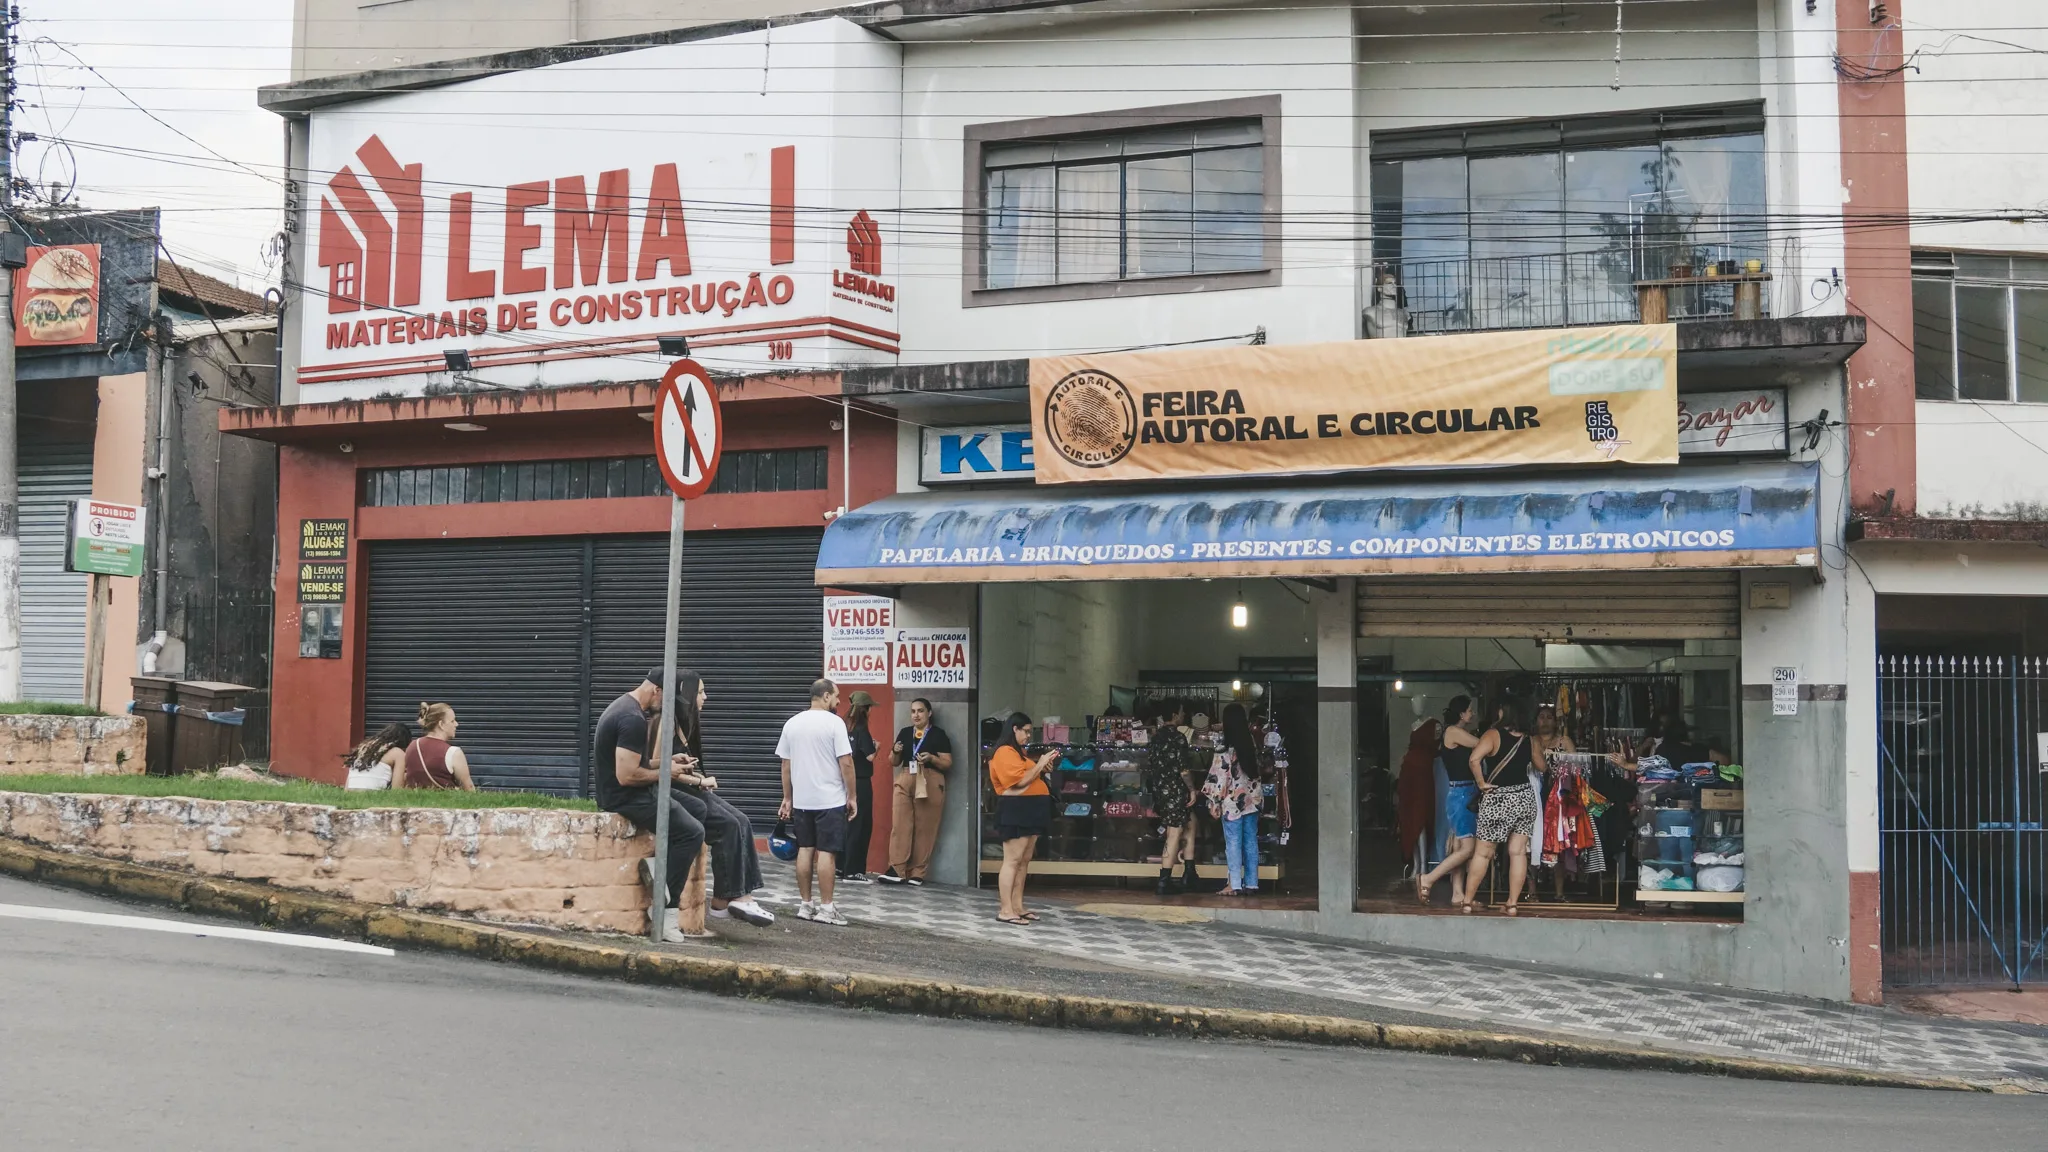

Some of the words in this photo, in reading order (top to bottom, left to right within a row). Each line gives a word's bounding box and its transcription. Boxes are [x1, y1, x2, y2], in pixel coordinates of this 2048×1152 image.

[833, 269, 895, 303] LEMAKI
[833, 292, 857, 302] MATERIAIS
[326, 307, 488, 350] MATERIAIS
[497, 300, 538, 333] DE
[549, 271, 795, 326] CONSTRUÇÃO
[767, 340, 793, 361] 300
[1055, 375, 1112, 402] AUTORAL
[1114, 390, 1124, 400] E
[1142, 388, 1246, 417] FEIRA
[1587, 402, 1608, 414] RE
[1140, 415, 1309, 445] AUTORAL
[1318, 414, 1342, 438] E
[1349, 405, 1541, 436] CIRCULAR
[1587, 414, 1612, 427] GIS
[1588, 427, 1617, 440] TRO
[1062, 442, 1126, 462] CIRCULAR
[91, 506, 135, 518] PROIBIDO
[315, 523, 345, 531] LEMAKI
[303, 536, 345, 549] ALUGA-SE
[879, 546, 1004, 564] PAPELARIA
[1020, 543, 1175, 565] BRINQUEDOS
[1191, 539, 1332, 560] PRESENTES
[1349, 534, 1542, 556] COMPONENTES
[1548, 529, 1735, 551] ELETRONICOS
[305, 550, 315, 558] (13)
[313, 566, 344, 575] LEMAKI
[300, 582, 344, 593] VENDE-SE
[302, 593, 312, 601] (13)
[827, 608, 890, 627] VENDE
[839, 628, 885, 636] 9.9746-5559
[931, 633, 967, 641] CHICAOKA
[896, 643, 966, 668] ALUGA
[827, 654, 886, 672] ALUGA
[898, 672, 911, 681] (13)
[911, 670, 964, 683] 99172-7514
[1775, 669, 1795, 681] 290
